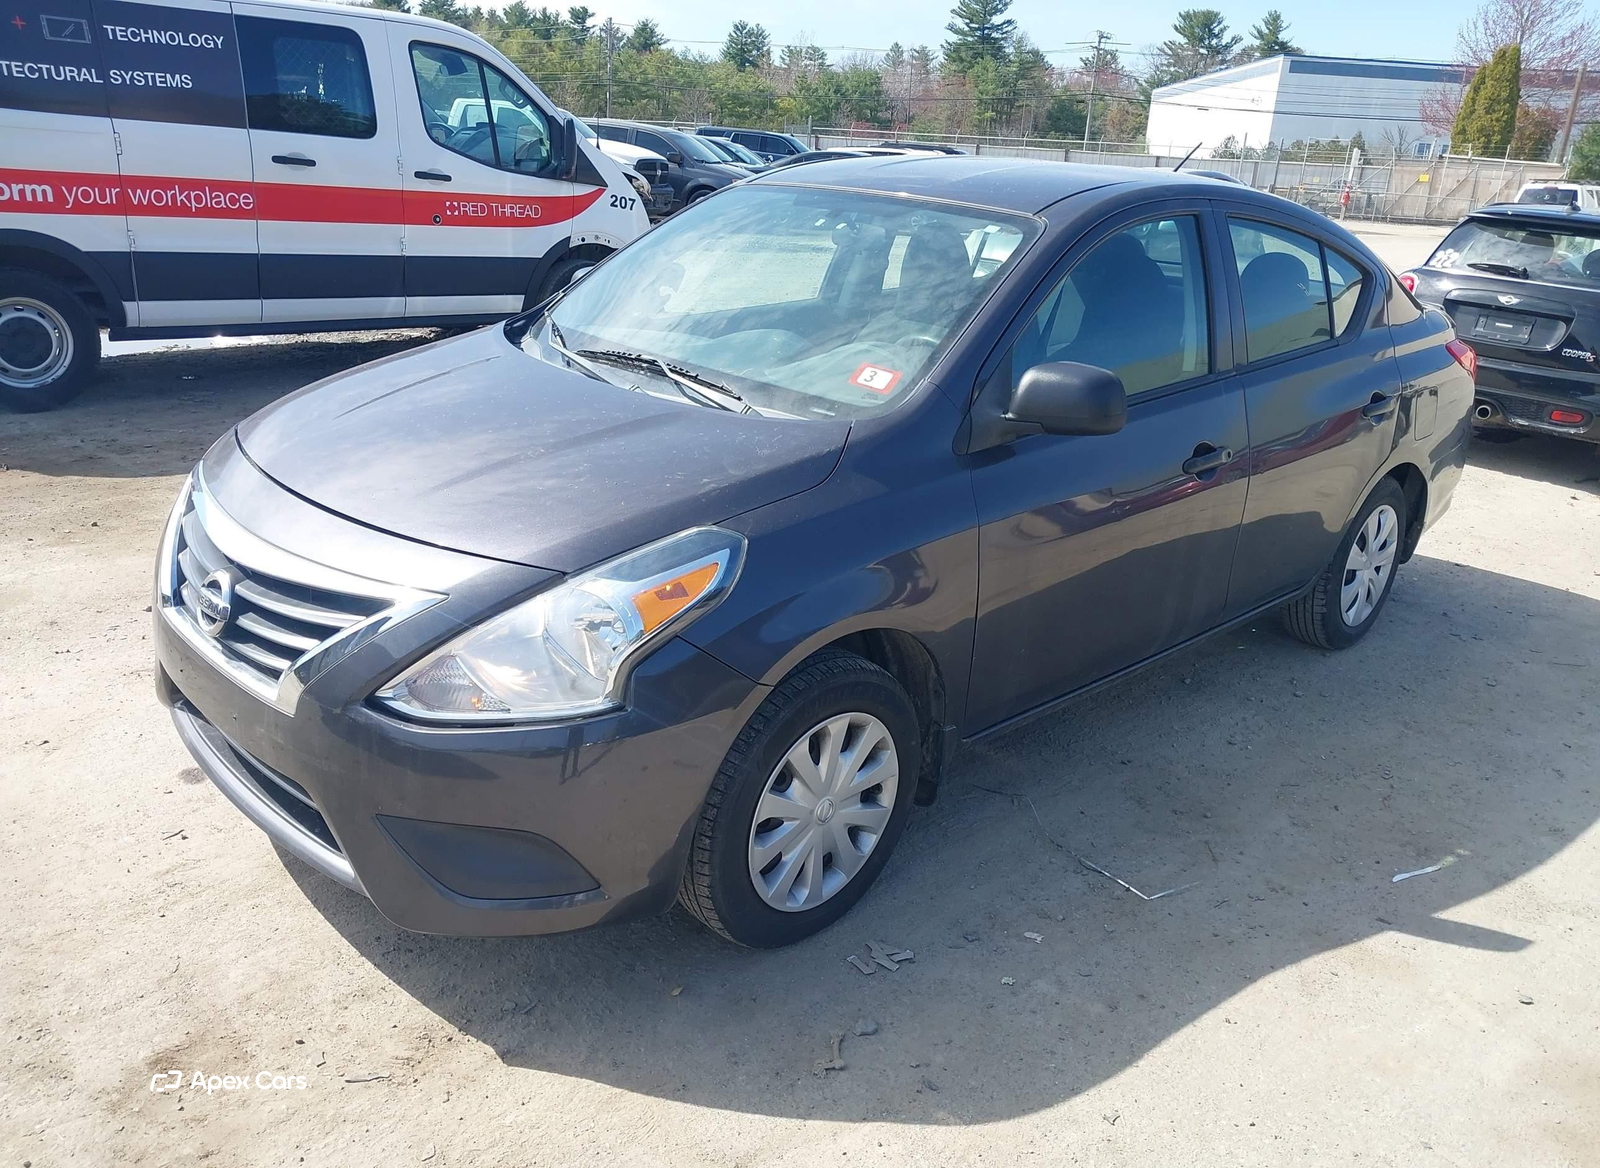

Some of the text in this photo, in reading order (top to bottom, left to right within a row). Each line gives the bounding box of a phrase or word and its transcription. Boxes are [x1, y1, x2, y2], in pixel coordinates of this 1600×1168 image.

[103, 25, 224, 49] TECHNOLOGY
[0, 61, 193, 89] TECTURAL SYSTEMS
[61, 185, 120, 209] your
[128, 185, 254, 212] workplace
[609, 194, 636, 212] 207
[460, 202, 541, 218] RED THREAD
[1561, 348, 1591, 360] COOPER
[863, 370, 878, 383] 3
